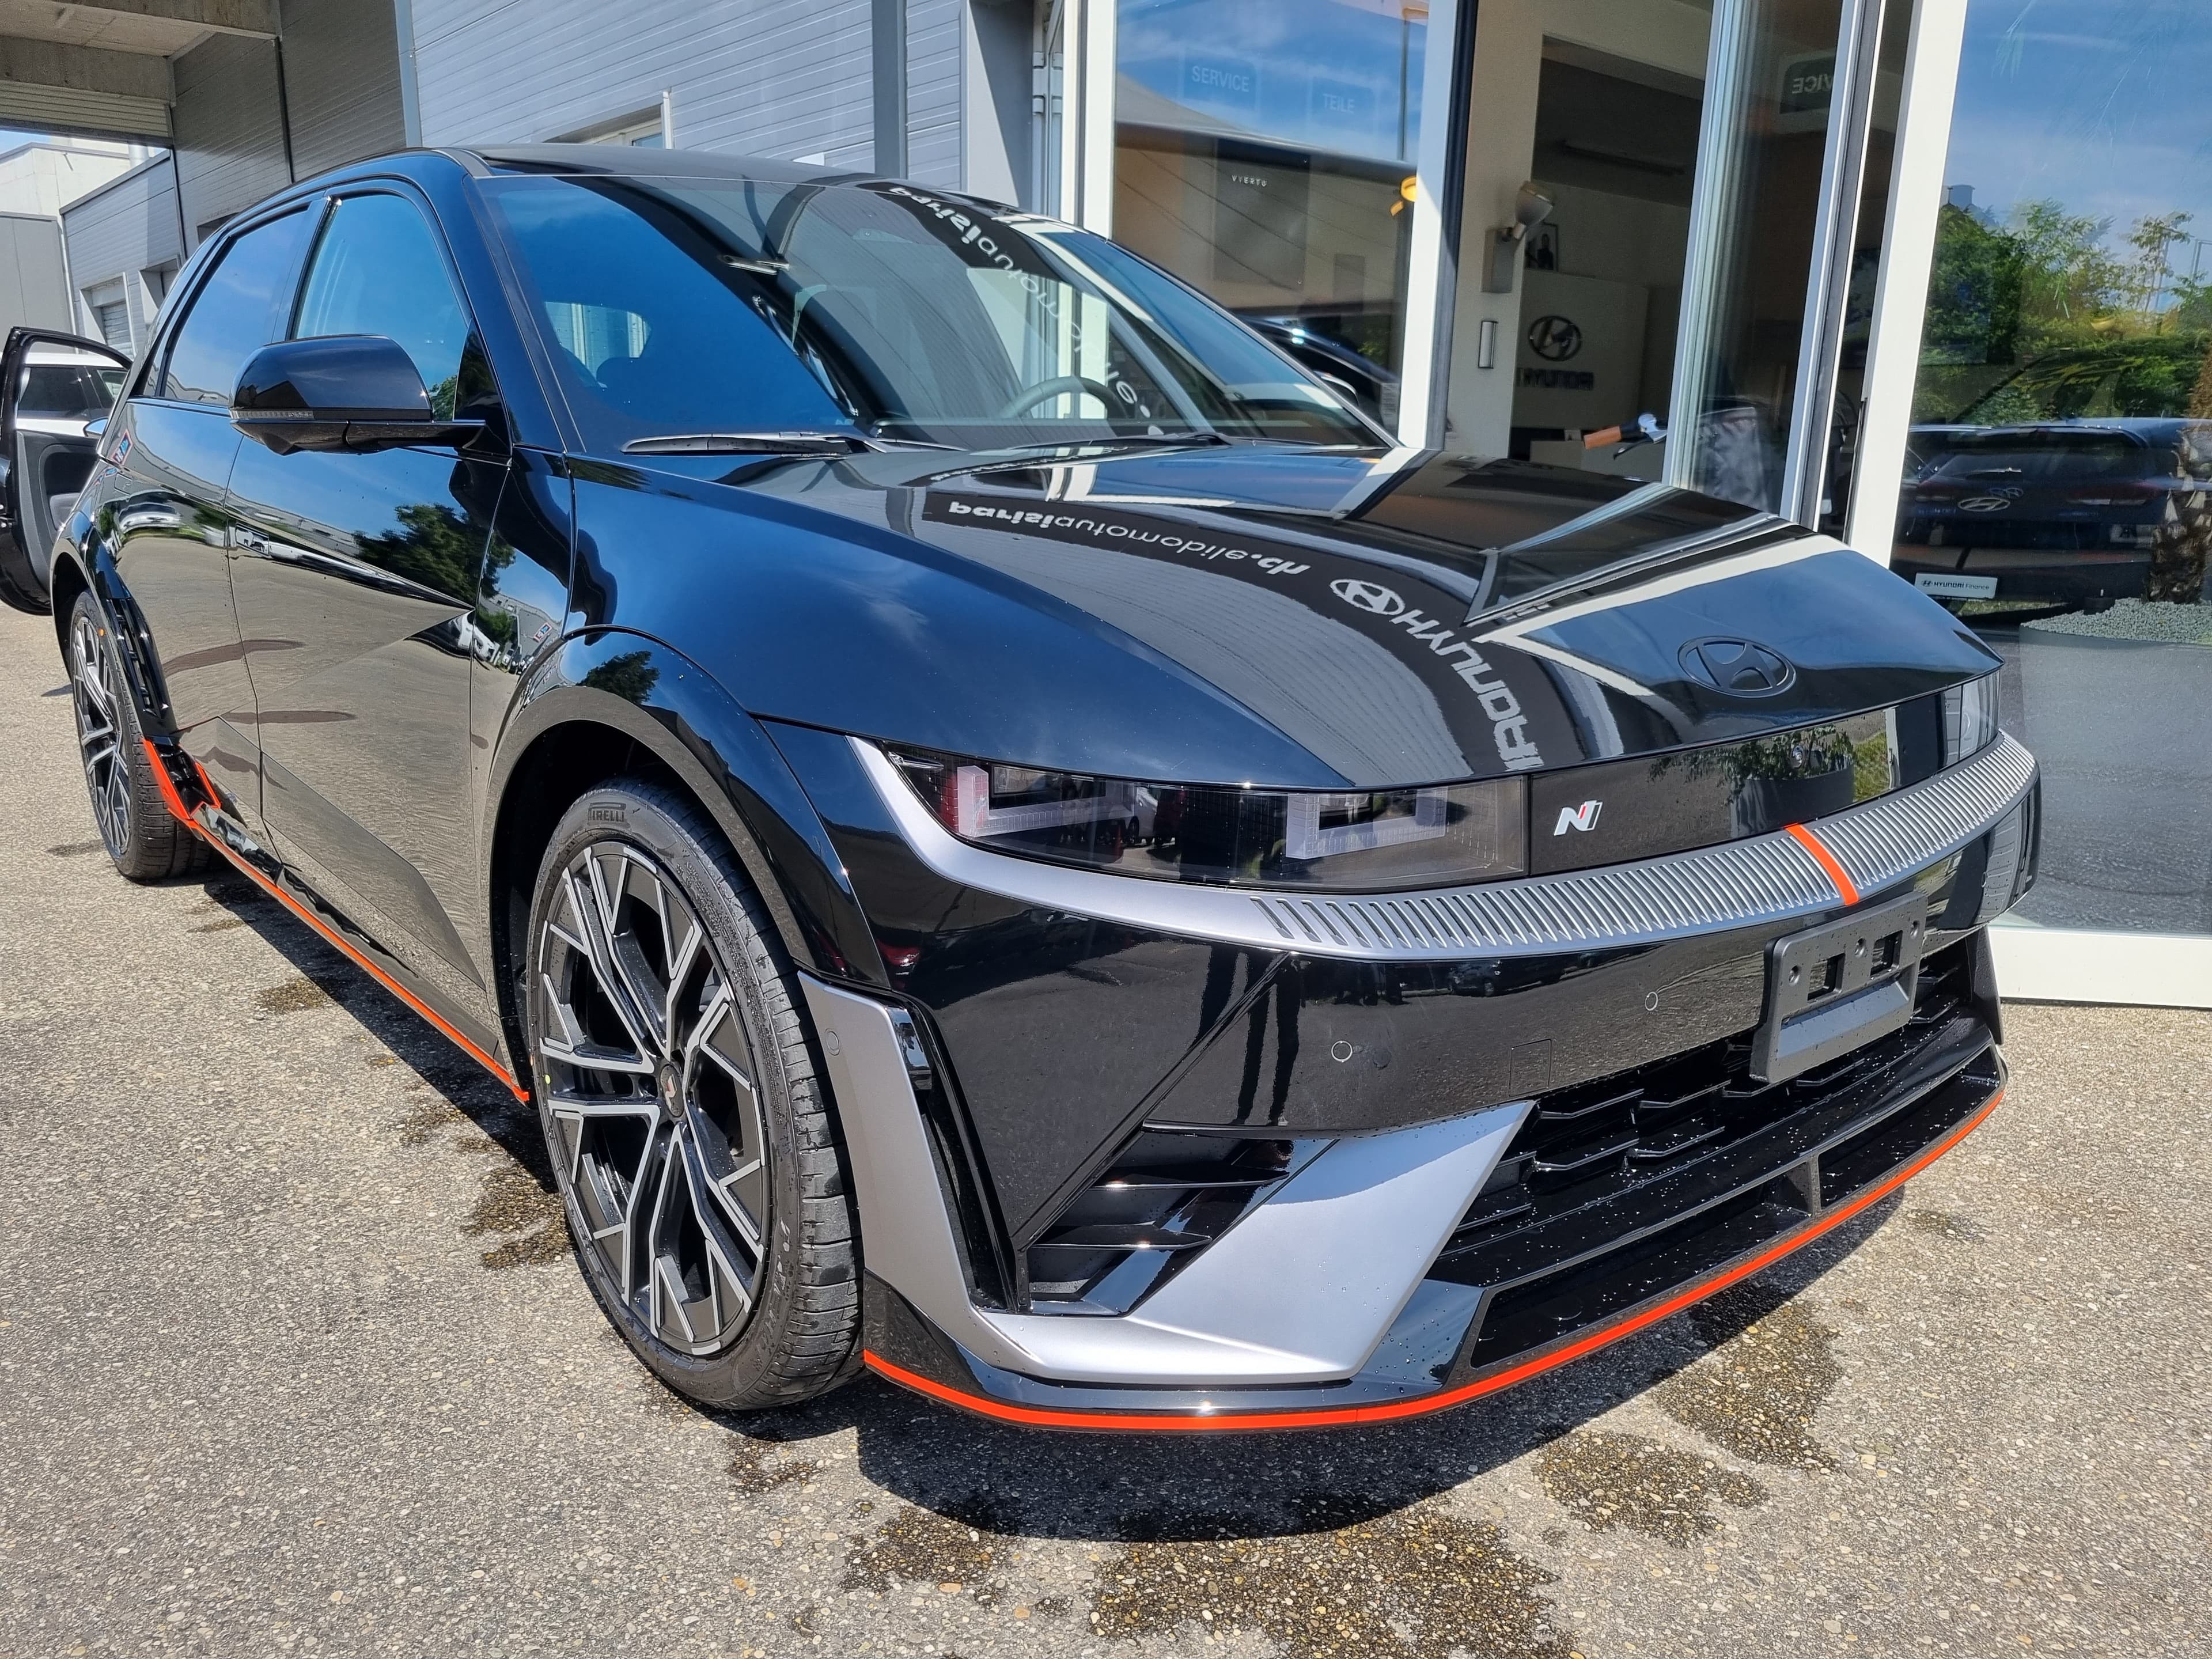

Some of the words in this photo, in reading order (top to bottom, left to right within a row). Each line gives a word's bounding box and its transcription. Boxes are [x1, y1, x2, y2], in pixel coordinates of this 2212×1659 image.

[1191, 65, 1249, 93] SERVICE
[1323, 93, 1355, 115] TEILE
[588, 802, 626, 822] PIRELLI
